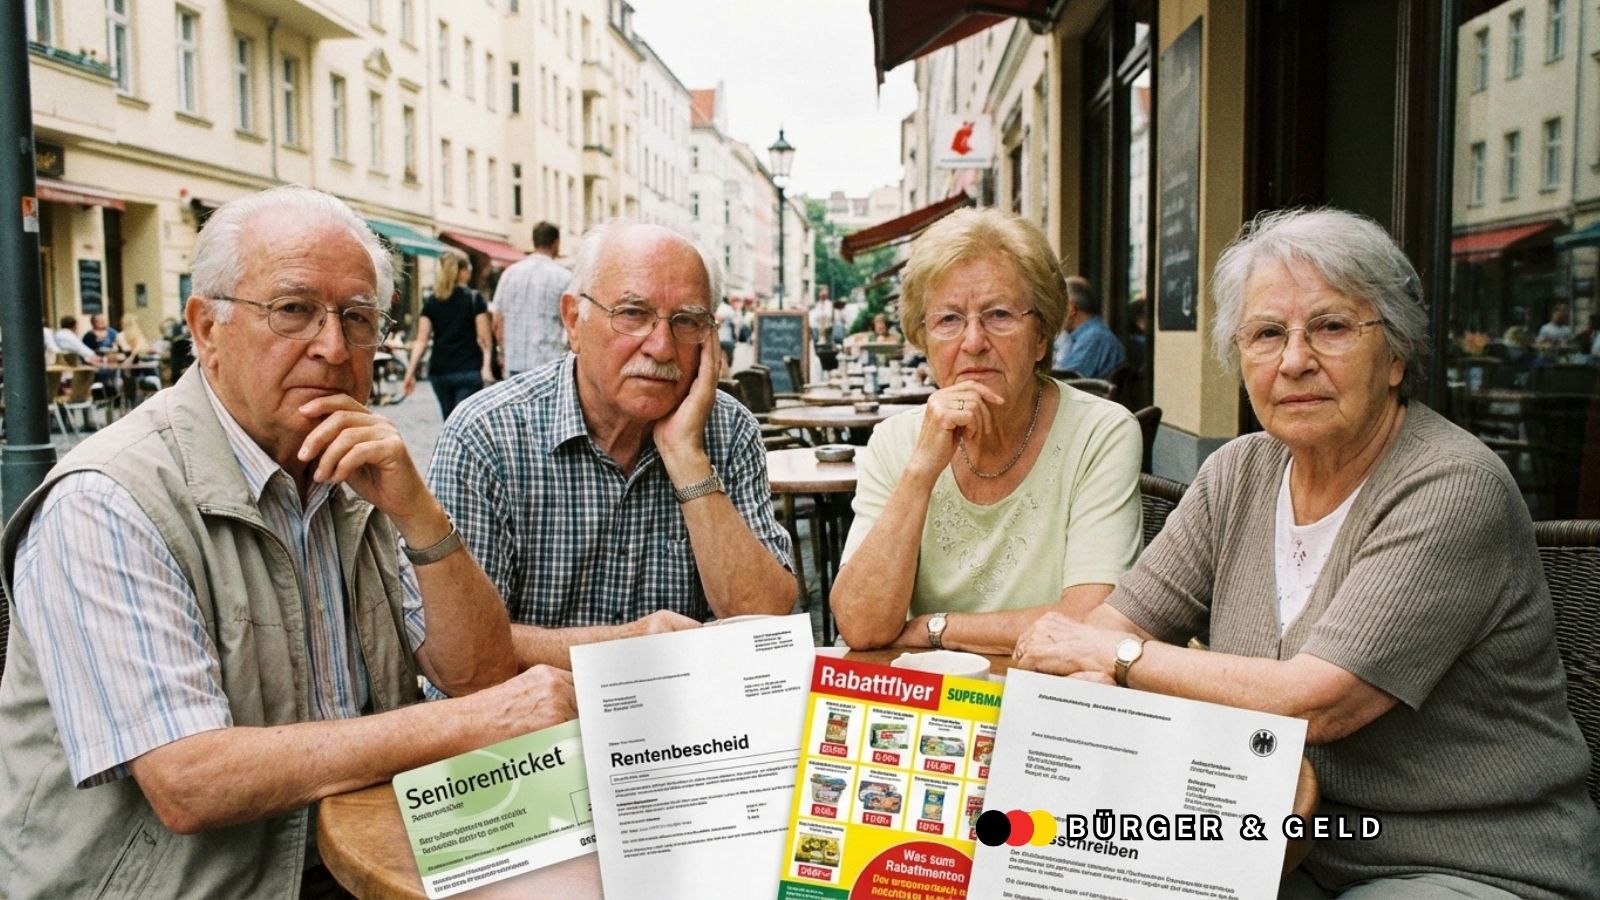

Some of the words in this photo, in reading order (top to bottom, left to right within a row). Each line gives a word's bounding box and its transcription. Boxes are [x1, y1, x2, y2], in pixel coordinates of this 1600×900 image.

[821, 665, 935, 702] Rabattflyer
[610, 733, 750, 769] Rentenbescheid
[405, 746, 566, 810] Seniorenticket
[904, 848, 927, 863] Was
